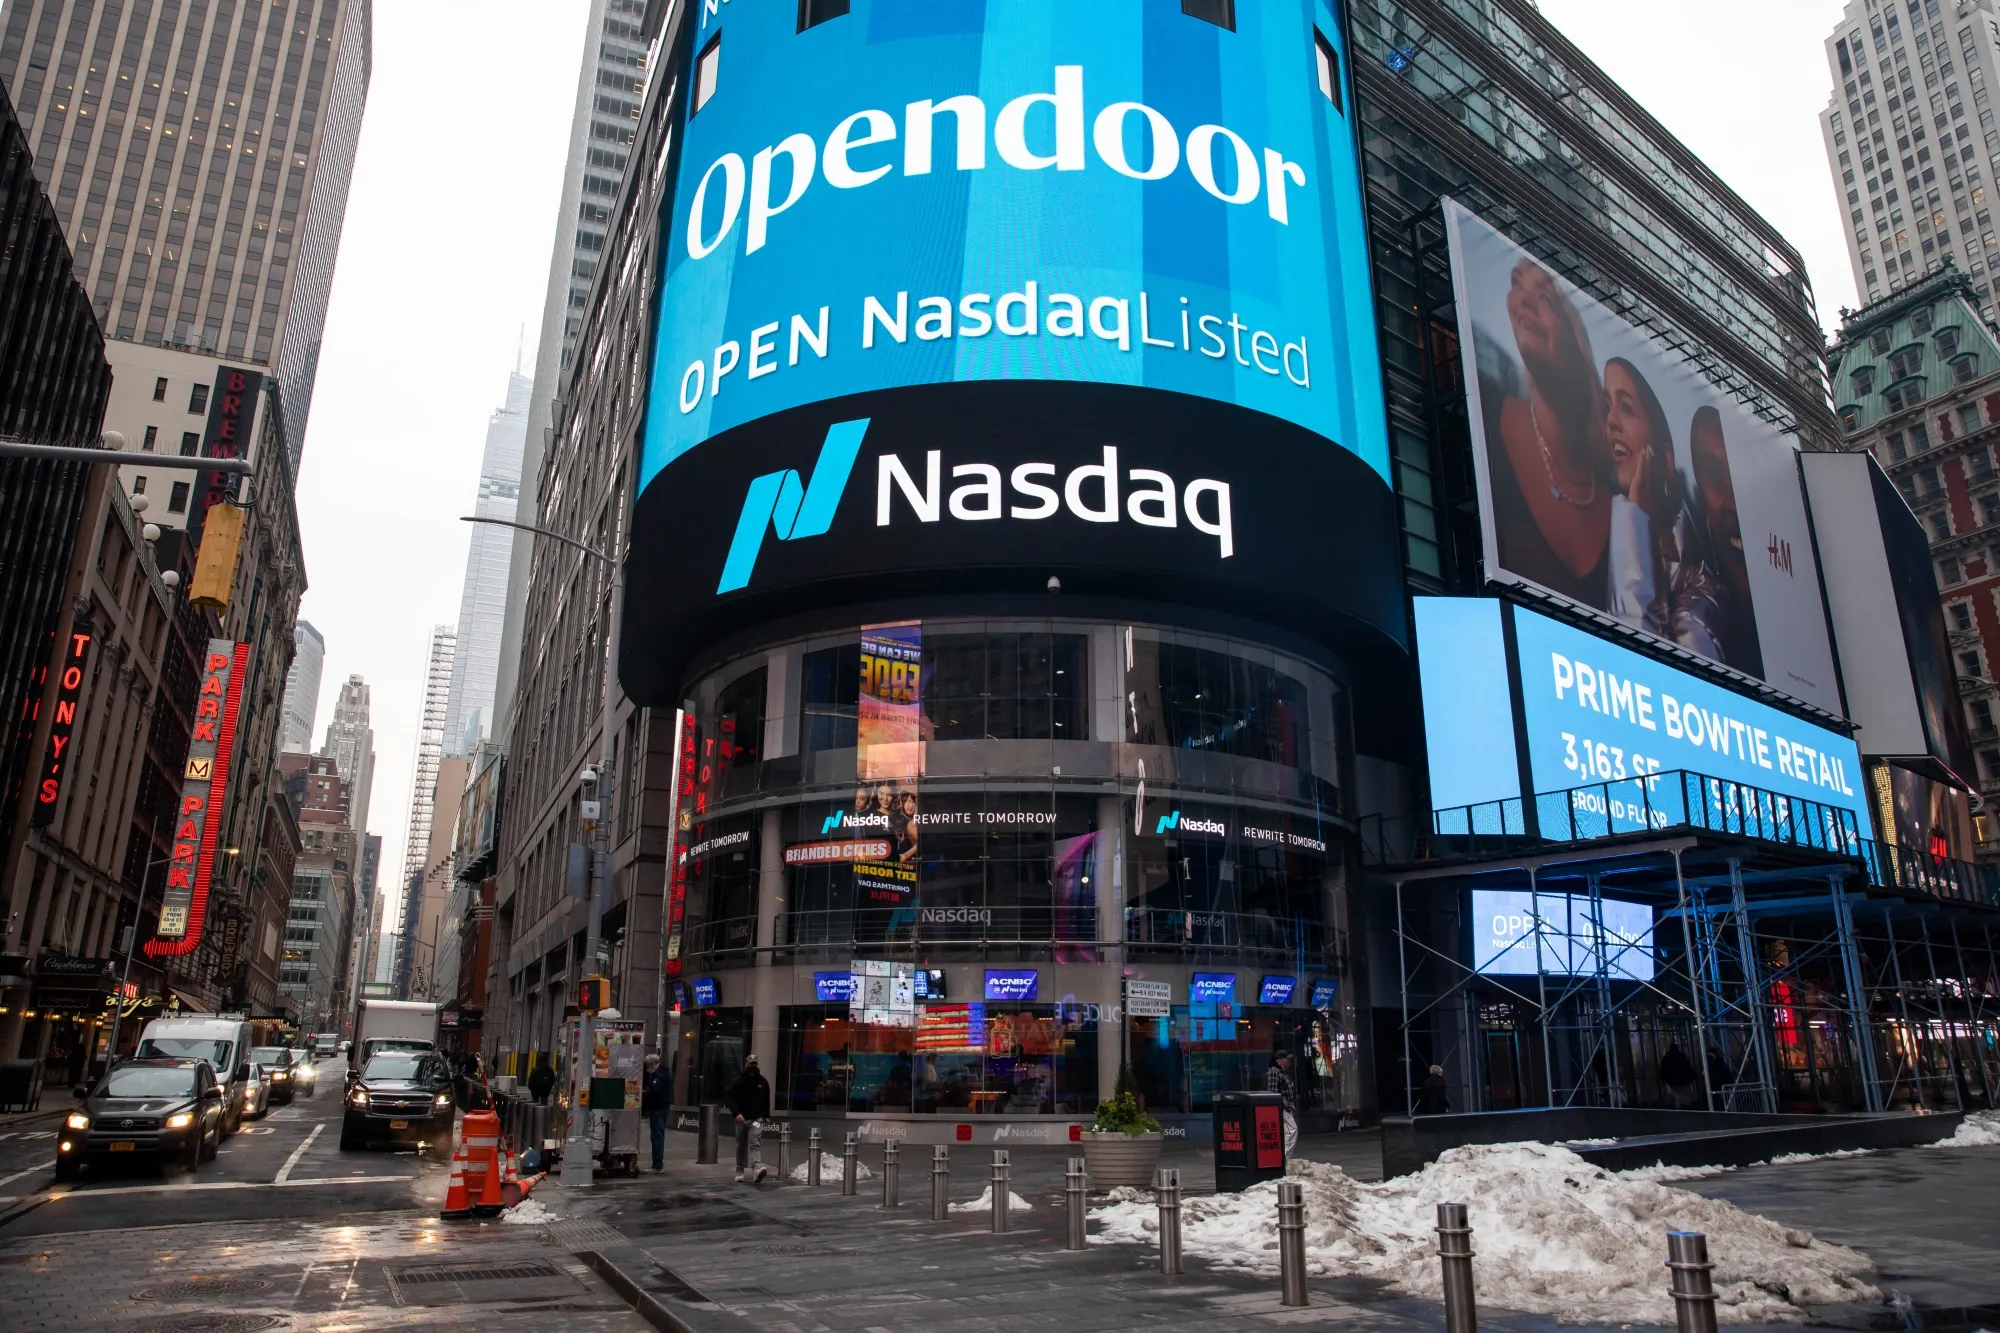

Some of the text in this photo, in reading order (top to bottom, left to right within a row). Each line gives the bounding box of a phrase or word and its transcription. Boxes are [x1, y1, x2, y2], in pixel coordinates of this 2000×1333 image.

[686, 65, 1306, 262] Opendoor
[679, 306, 829, 414] OPEN
[875, 446, 1234, 559] Nasdaq
[1767, 532, 1793, 579] H&M
[195, 653, 229, 742] PARK
[40, 634, 90, 804] TONY'S
[1551, 651, 1854, 797] PRIME BOWTIE RETAIL
[1561, 731, 1661, 792] 3,163 SF
[1572, 789, 1624, 819] GROUND
[843, 813, 889, 828] Nasdaq
[913, 812, 1057, 825] REWRITE TOMORROW
[1180, 816, 1225, 837] Nasdaq
[169, 795, 204, 889] PARK
[690, 830, 750, 857] REWRITE TOMORROW
[1244, 826, 1285, 843] REWRITE
[785, 842, 887, 863] BRANDED CITIES
[922, 906, 991, 927] Nasdaq
[221, 918, 239, 980] BREWERY
[1130, 981, 1150, 990] PEDESTRIAN
[872, 1126, 907, 1138] Nasdaq
[1011, 1126, 1049, 1139] Nasdaq
[1223, 1121, 1240, 1129] ALL IN
[1221, 1141, 1243, 1151] SQUARE
[1222, 1132, 1240, 1141] TIMES
[1259, 1132, 1278, 1141] TIMES
[1259, 1141, 1280, 1151] SQUARE
